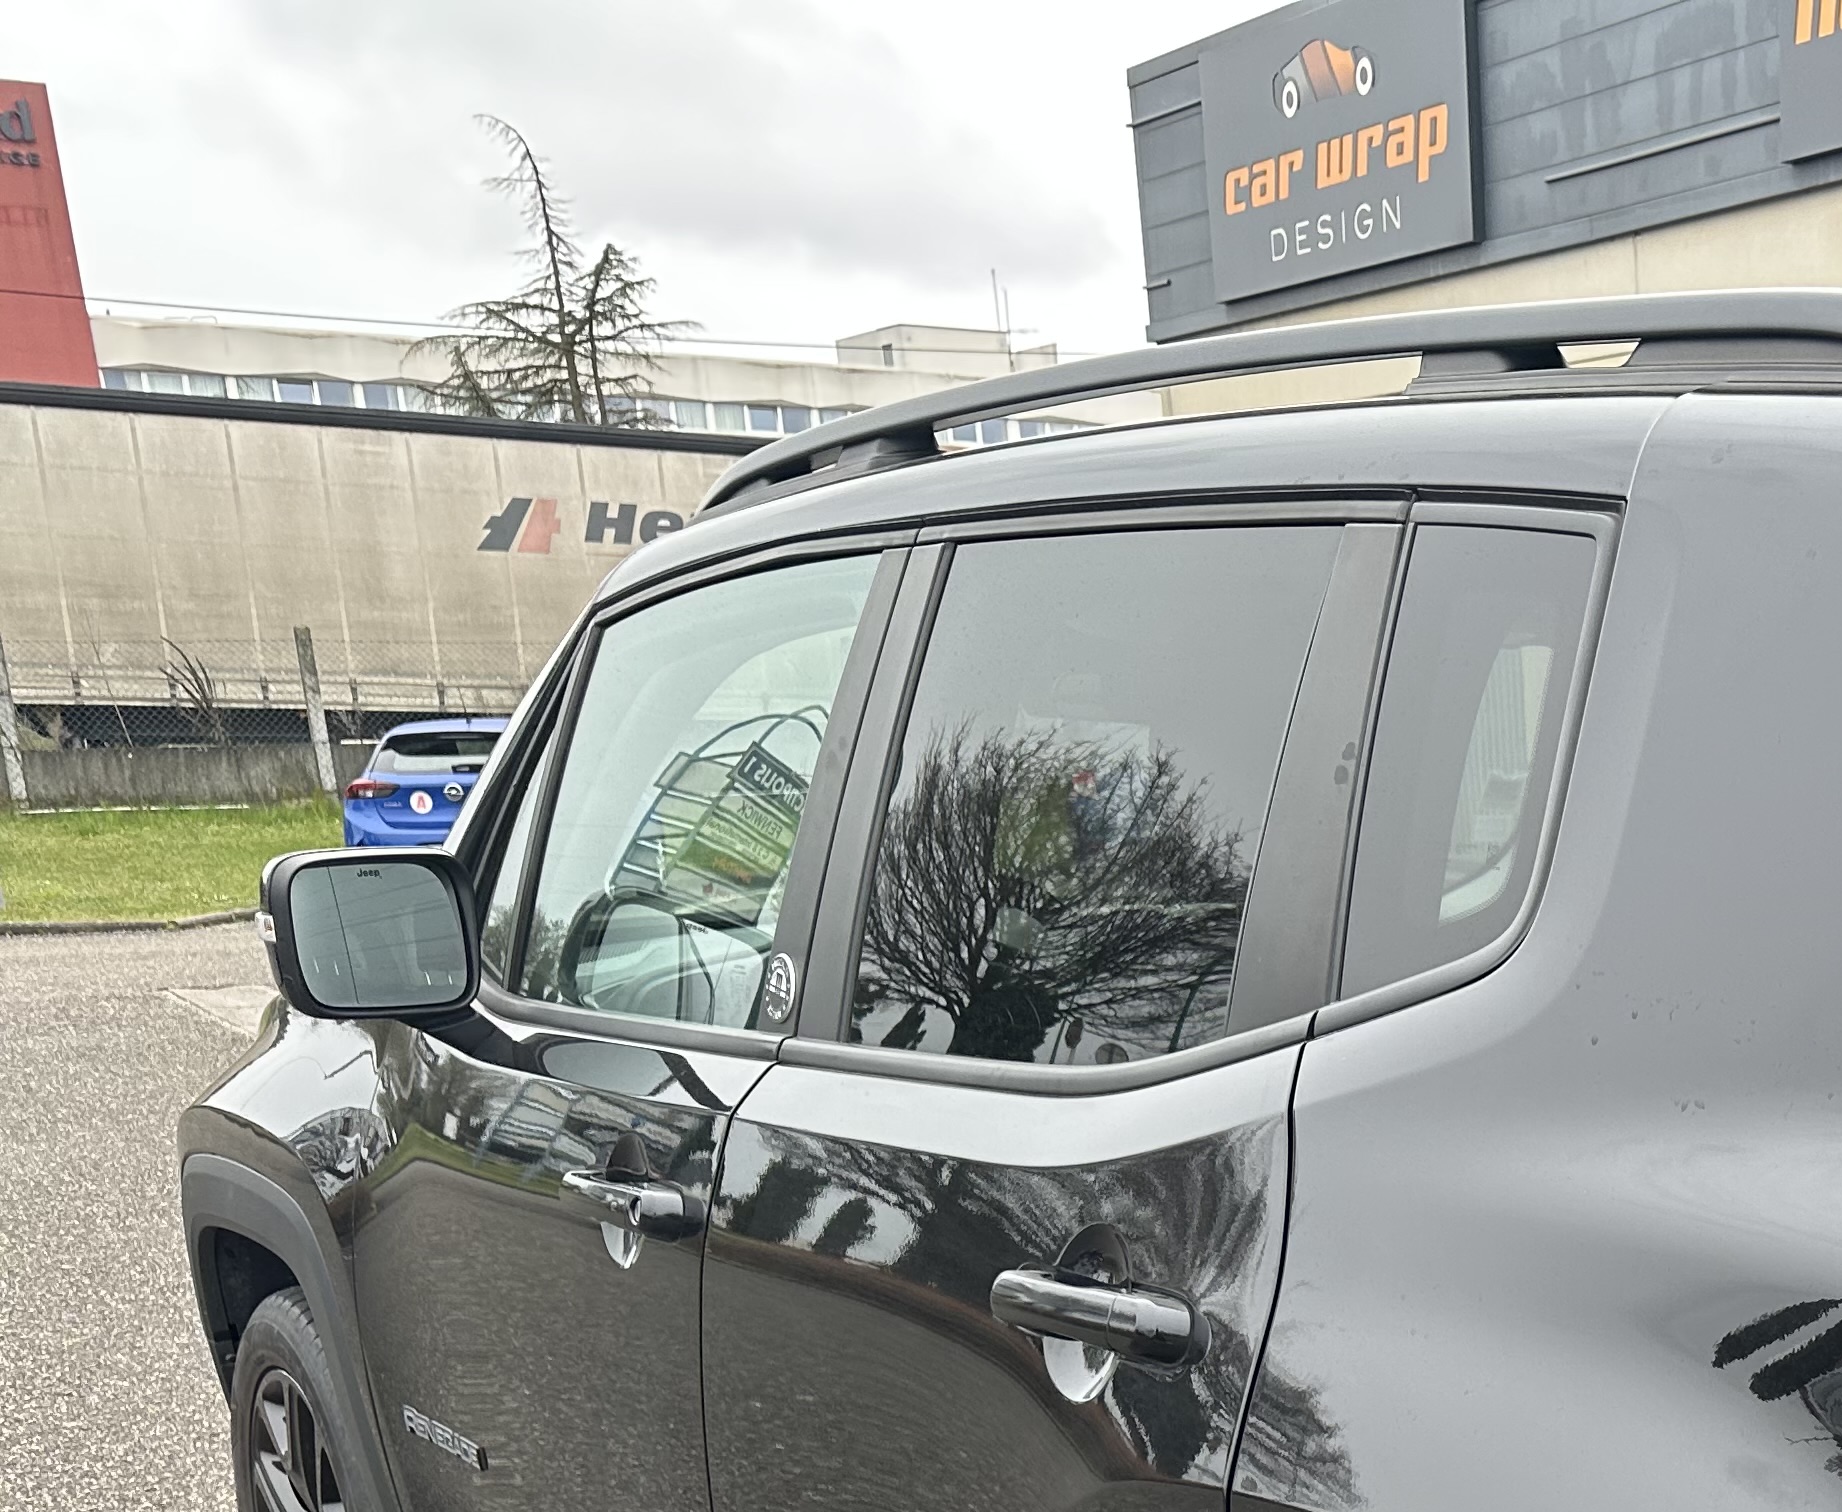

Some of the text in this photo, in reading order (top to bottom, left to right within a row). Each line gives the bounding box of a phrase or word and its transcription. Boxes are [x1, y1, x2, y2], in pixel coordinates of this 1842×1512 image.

[1224, 102, 1449, 216] car wrap
[1270, 195, 1402, 263] DESIGN
[356, 868, 380, 878] Jeep
[402, 1404, 487, 1471] RENEGADE
